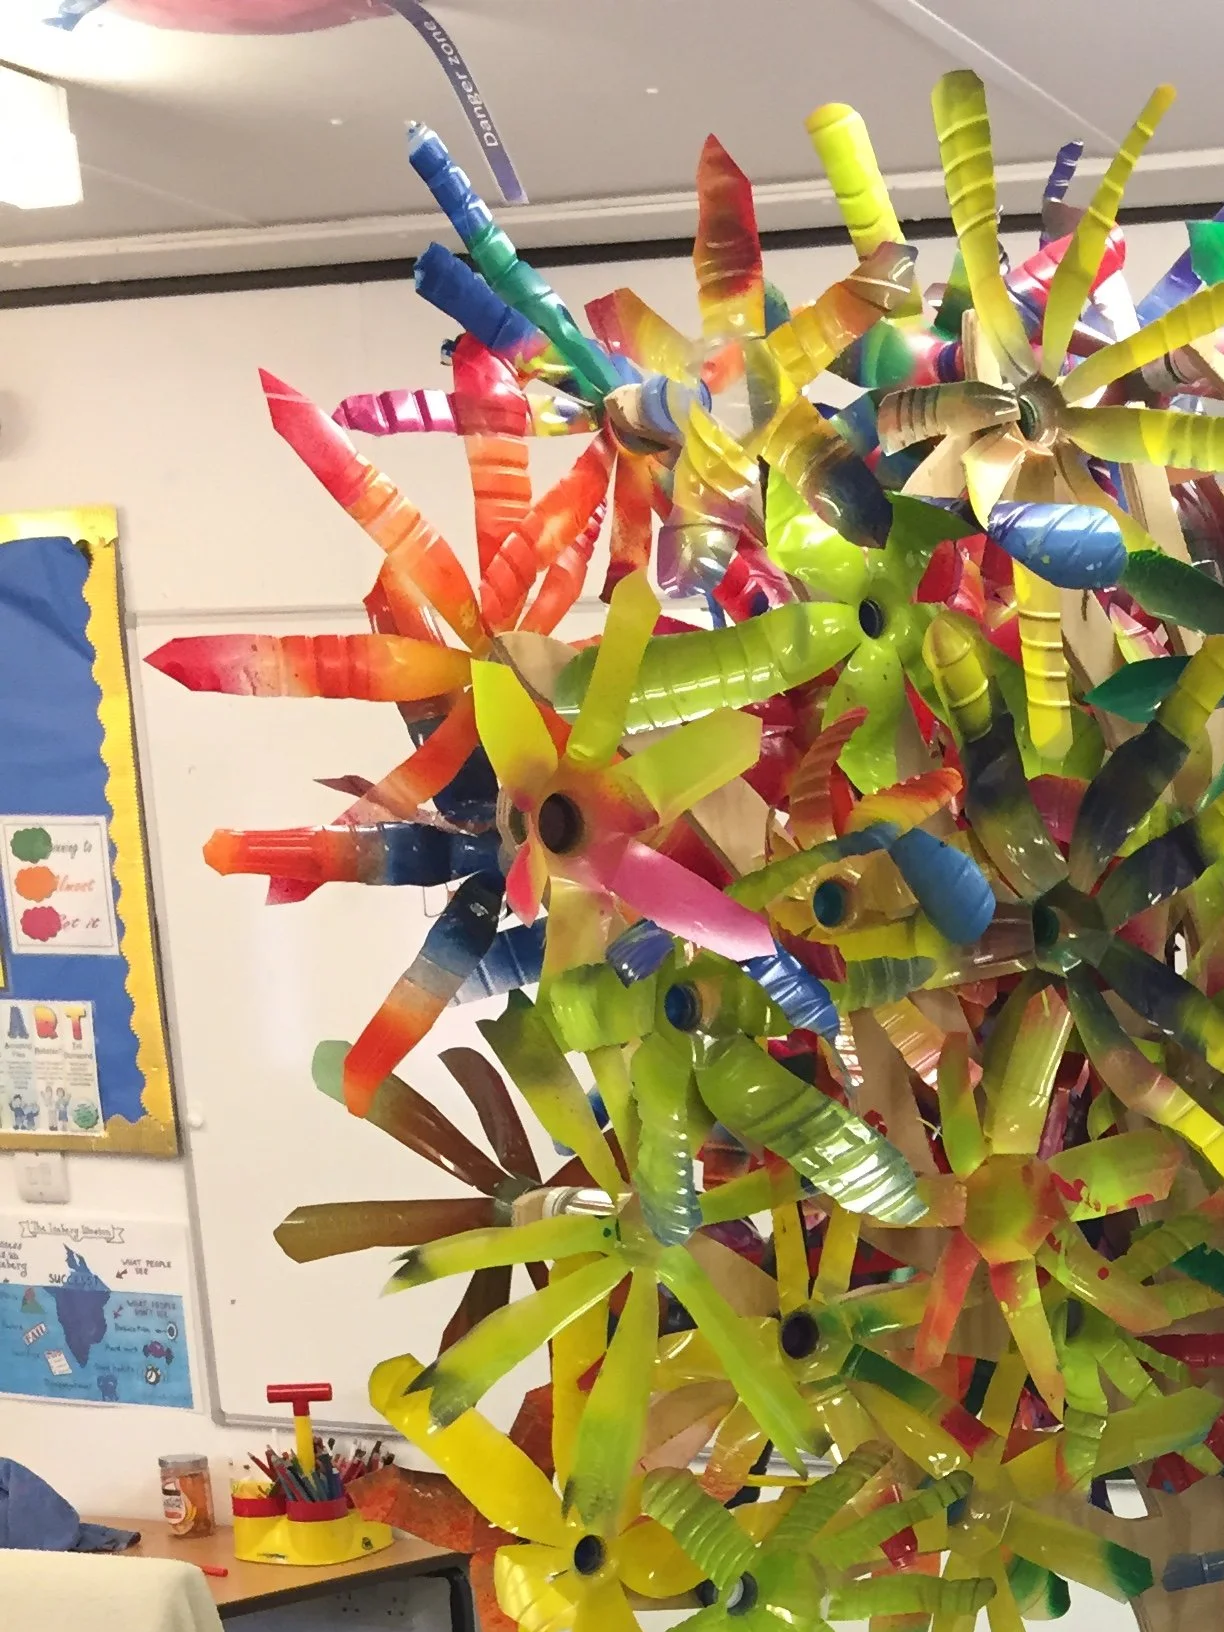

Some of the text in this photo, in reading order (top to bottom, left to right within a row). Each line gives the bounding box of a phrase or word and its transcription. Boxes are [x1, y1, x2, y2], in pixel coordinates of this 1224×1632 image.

[423, 20, 499, 147] Danger zone
[85, 917, 100, 929] it
